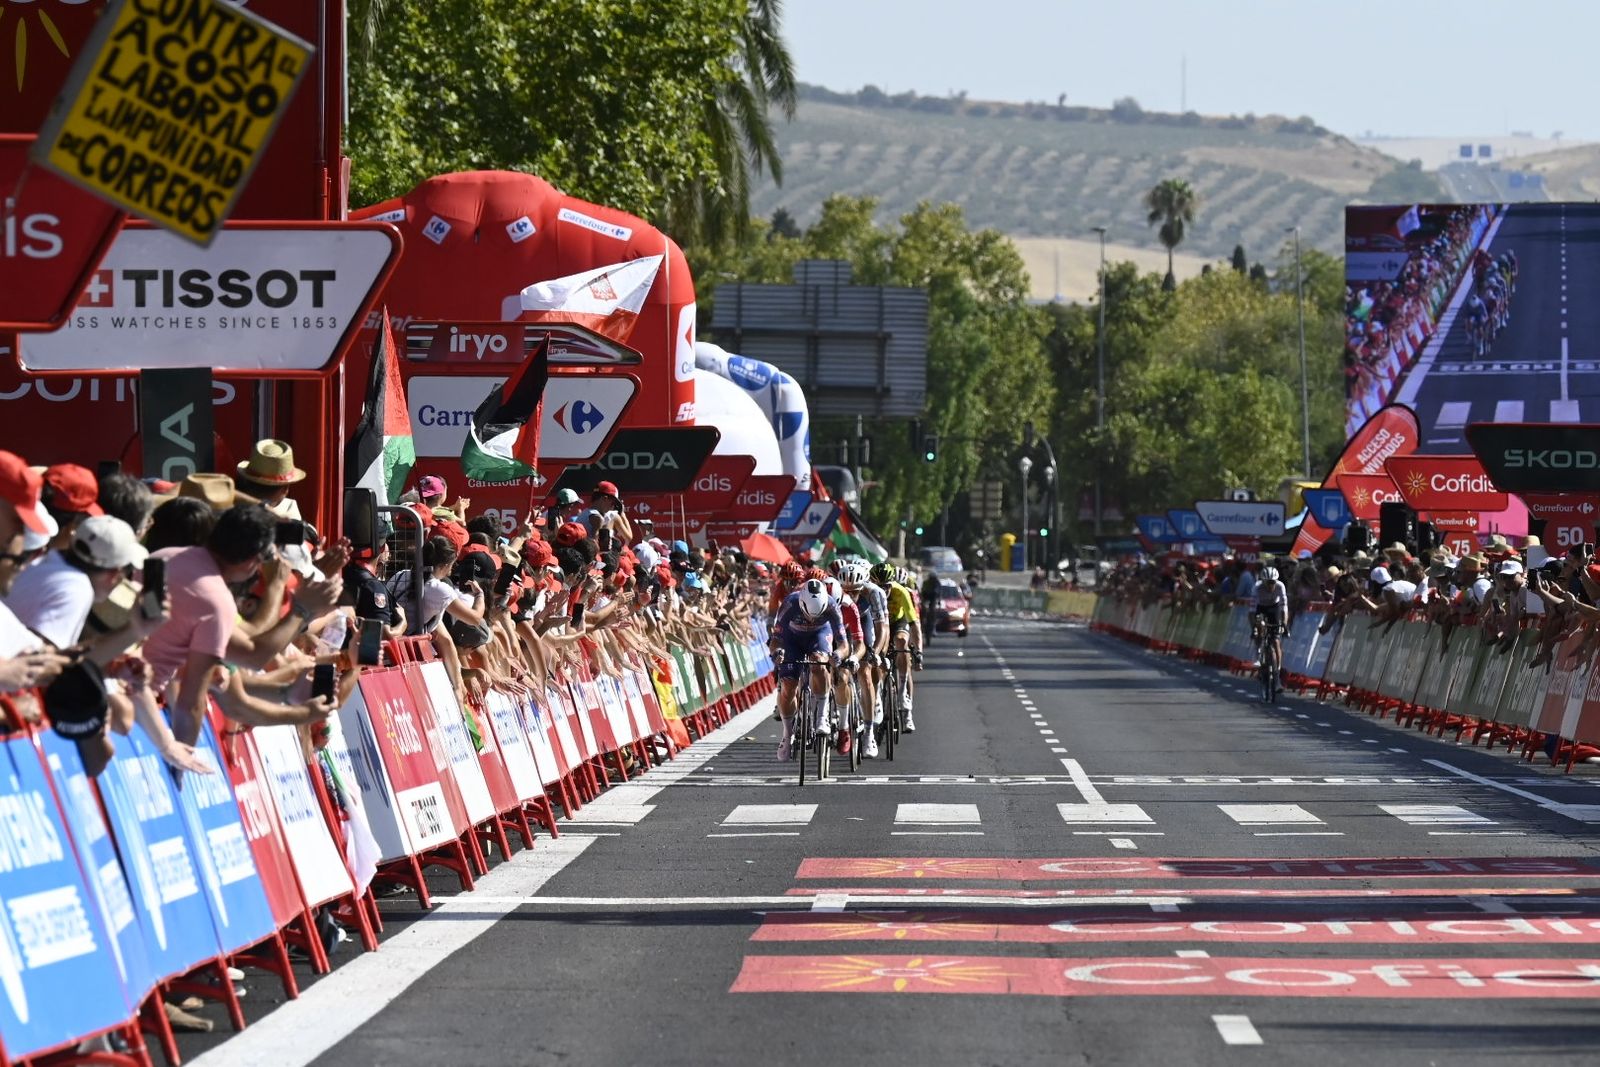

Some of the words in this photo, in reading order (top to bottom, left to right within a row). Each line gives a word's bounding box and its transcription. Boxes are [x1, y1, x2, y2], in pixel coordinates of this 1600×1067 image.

[132, 0, 278, 81] CONTRA
[114, 17, 278, 118] ACOSO
[98, 47, 253, 155] LABORAL
[78, 133, 225, 233] CORREOS
[563, 212, 608, 233] Carrefour
[122, 269, 336, 308] TISSOT
[67, 317, 99, 328] ISS
[111, 317, 206, 328] WATCHES
[219, 317, 280, 328] SINCE
[292, 317, 337, 328] 1853
[450, 326, 507, 360] iryo
[1357, 428, 1390, 464] ACCESO
[1431, 474, 1497, 493] Cofidis
[1533, 504, 1573, 513] Carrefour
[1436, 518, 1463, 526] Carrefour
[1557, 526, 1584, 546] 50
[1452, 540, 1470, 556] 75
[1039, 860, 1577, 874] Cofidis
[1048, 918, 1600, 937] Cofidi
